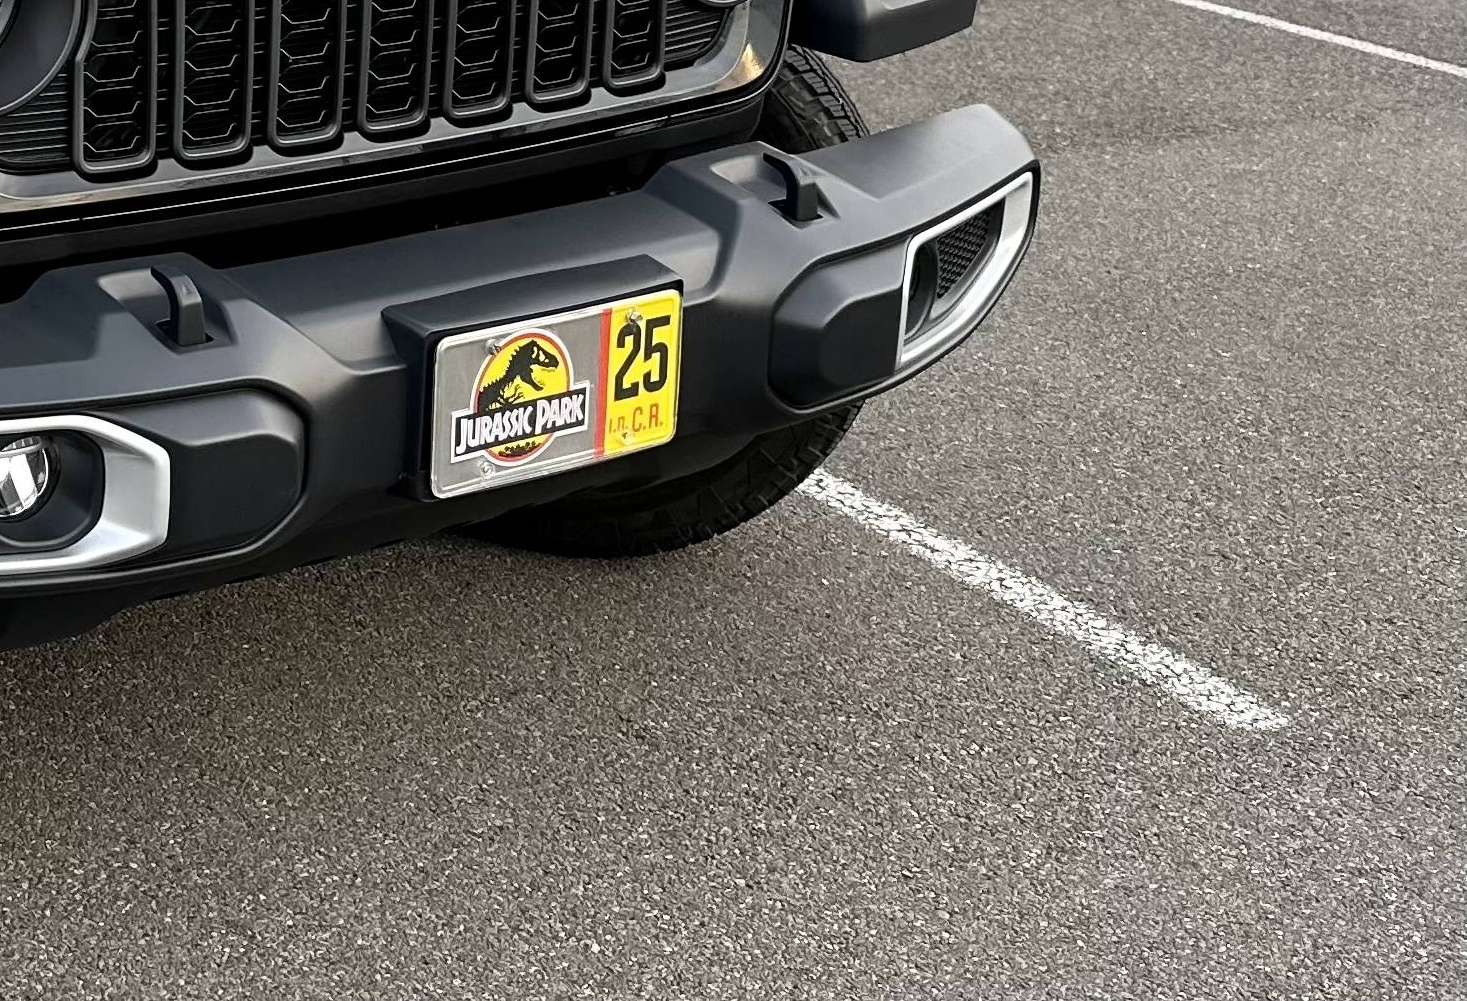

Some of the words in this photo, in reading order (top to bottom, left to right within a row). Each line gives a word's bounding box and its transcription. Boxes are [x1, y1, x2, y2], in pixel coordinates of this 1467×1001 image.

[613, 314, 672, 403] 25
[455, 407, 534, 455] JURASSIC
[535, 393, 585, 435] PARK
